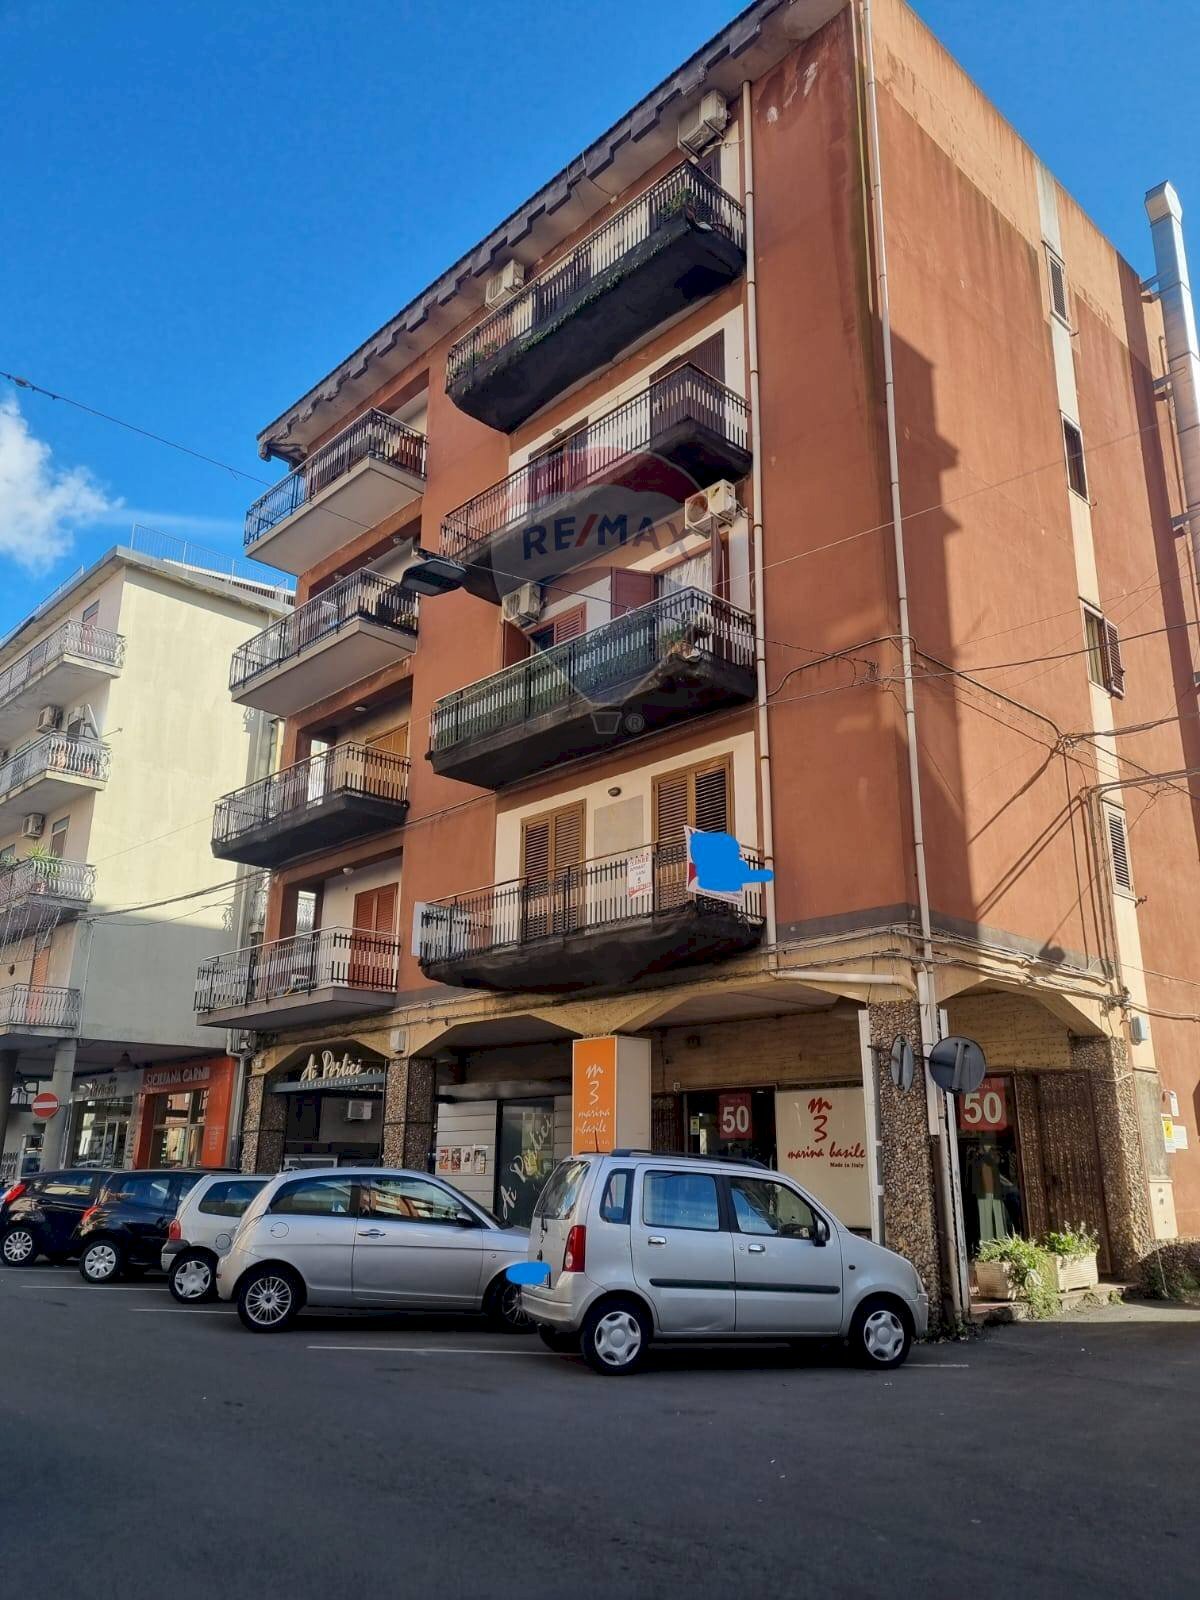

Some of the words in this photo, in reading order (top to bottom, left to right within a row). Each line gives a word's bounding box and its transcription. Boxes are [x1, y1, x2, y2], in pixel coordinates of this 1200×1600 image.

[300, 1053, 319, 1081] Ai
[322, 1050, 362, 1080] Portici
[578, 1107, 611, 1119] marina
[722, 1105, 749, 1133] 50
[964, 1091, 1002, 1124] 50
[580, 1119, 608, 1134] basile
[787, 1146, 825, 1160] marina
[829, 1141, 866, 1158] basile
